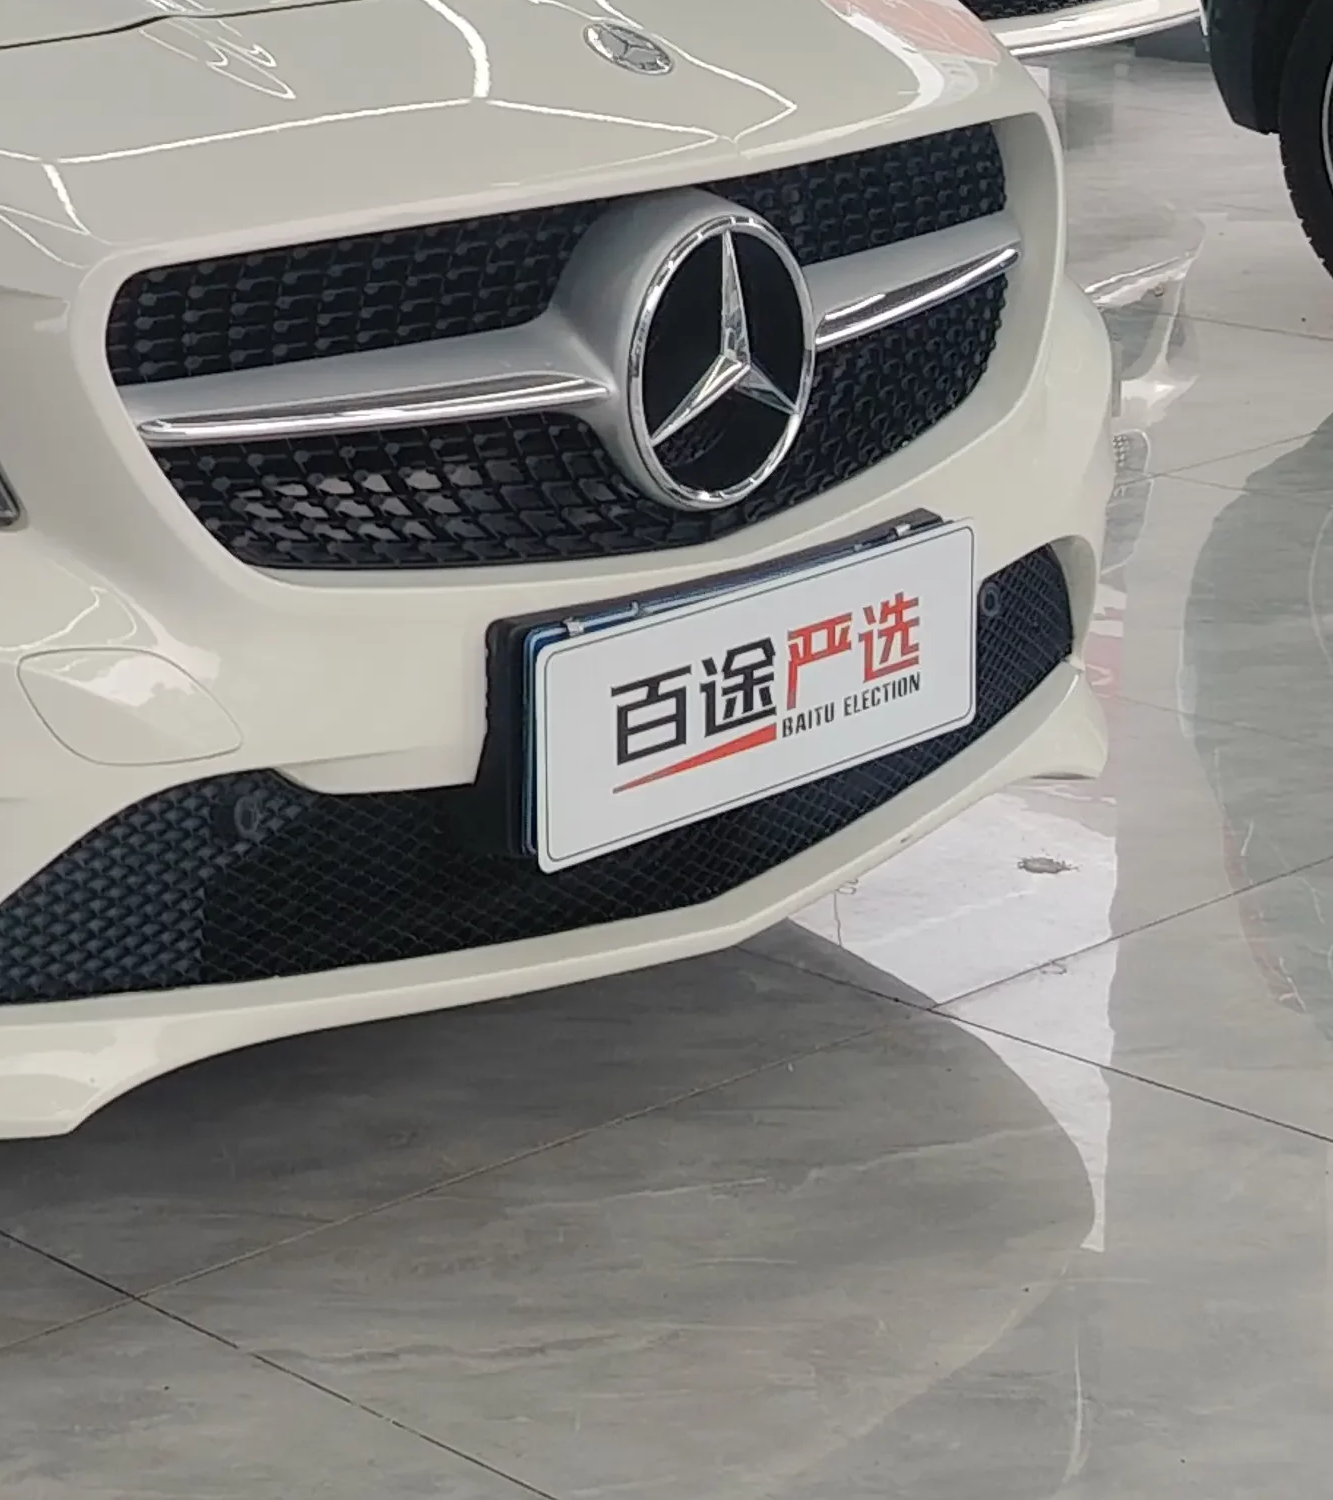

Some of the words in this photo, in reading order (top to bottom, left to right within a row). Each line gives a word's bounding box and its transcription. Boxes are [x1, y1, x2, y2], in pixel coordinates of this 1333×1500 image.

[610, 591, 920, 766] 百途严选
[782, 701, 835, 739] BAITU
[843, 671, 921, 717] ELECTION
